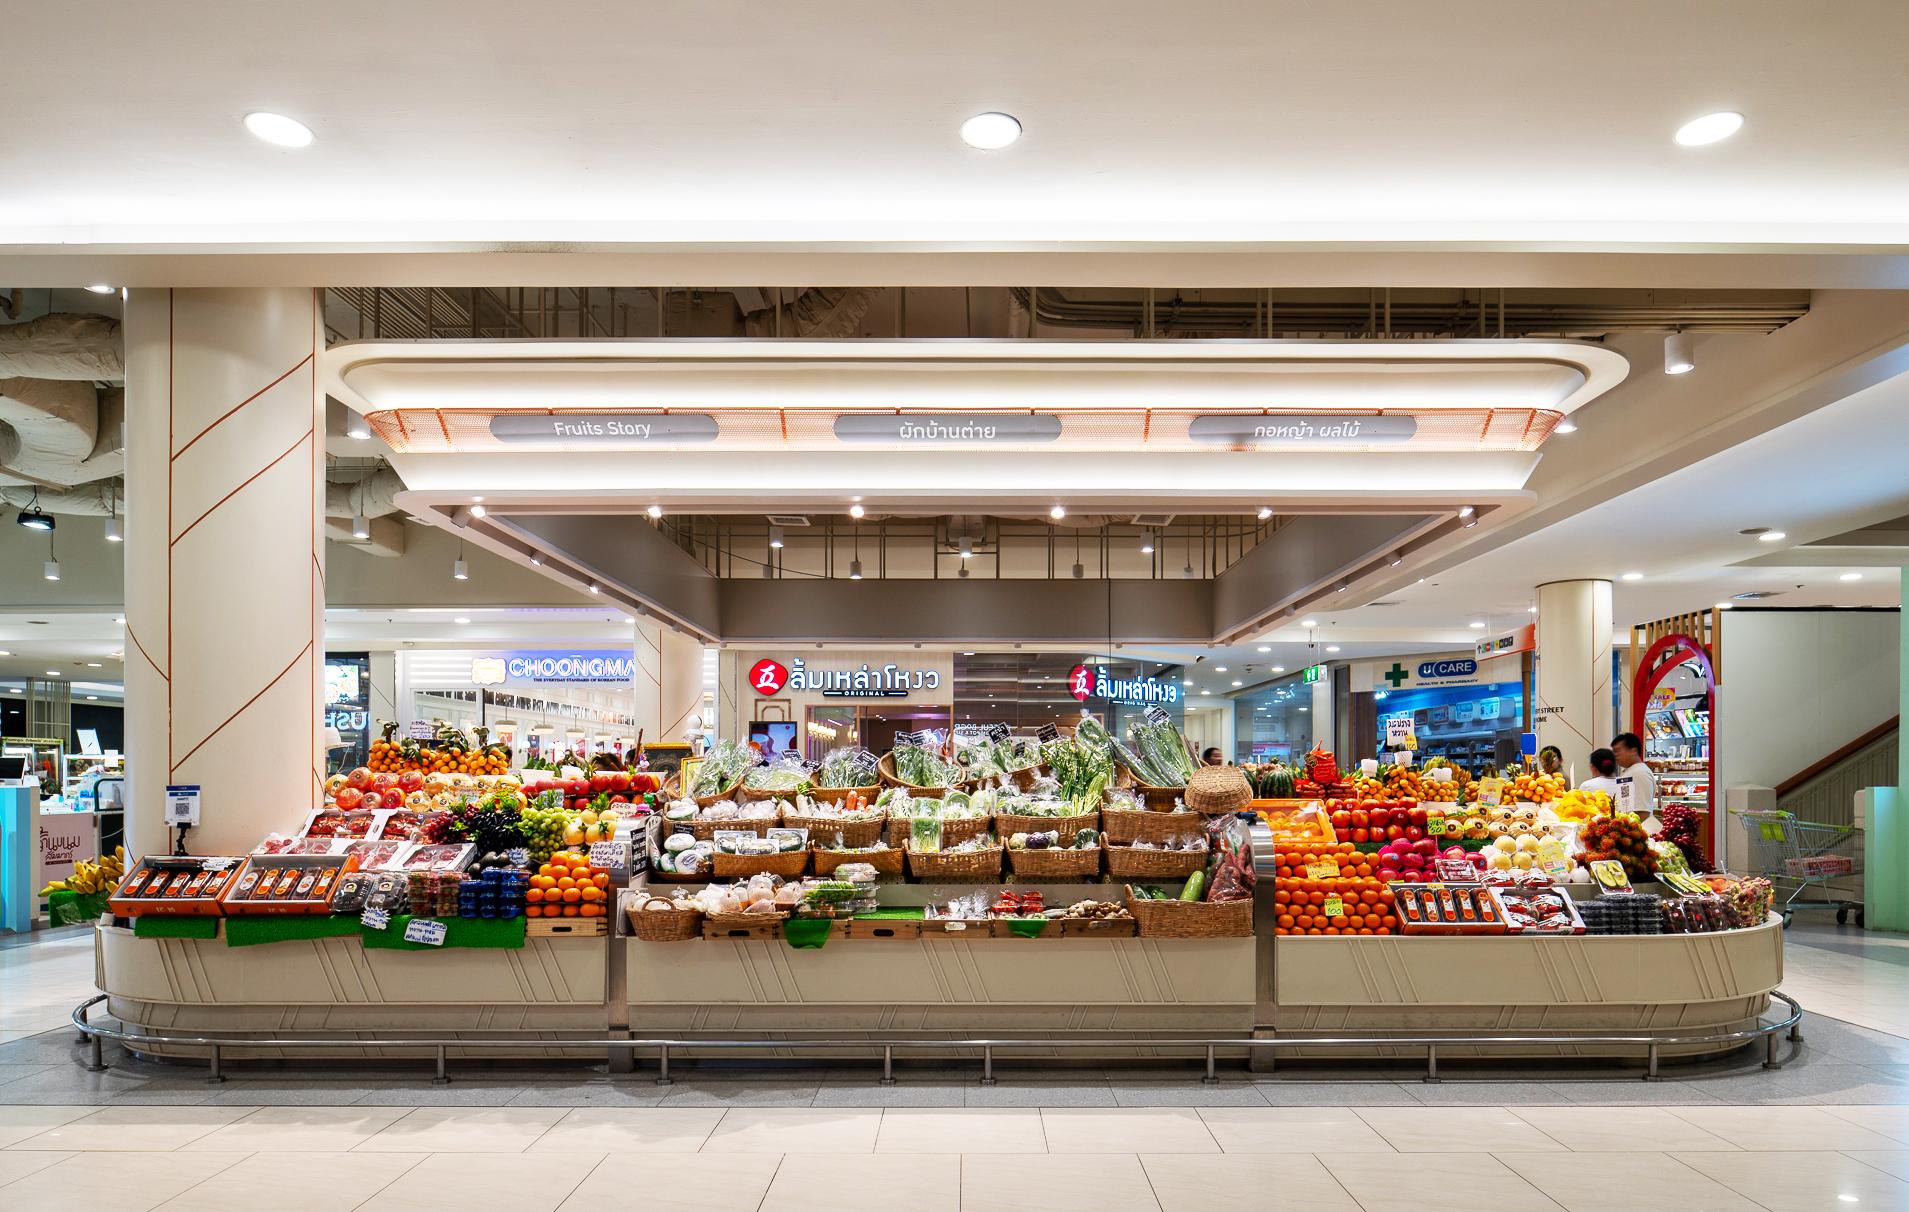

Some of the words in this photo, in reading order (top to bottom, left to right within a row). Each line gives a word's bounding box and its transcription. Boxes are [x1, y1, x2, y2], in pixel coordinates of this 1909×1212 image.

[554, 422, 602, 436] Fruits
[607, 422, 651, 438] Story
[899, 420, 996, 439] ผักบ้านต่าย
[1254, 420, 1313, 440] กอหญ้า
[1319, 420, 1362, 438] ผลไม้
[790, 658, 940, 690] ลิ้มเหล่าโหงว
[1424, 665, 1431, 674] U
[1439, 662, 1472, 673] CARE
[1096, 666, 1177, 702] ลิ้มเหล่าโหงว
